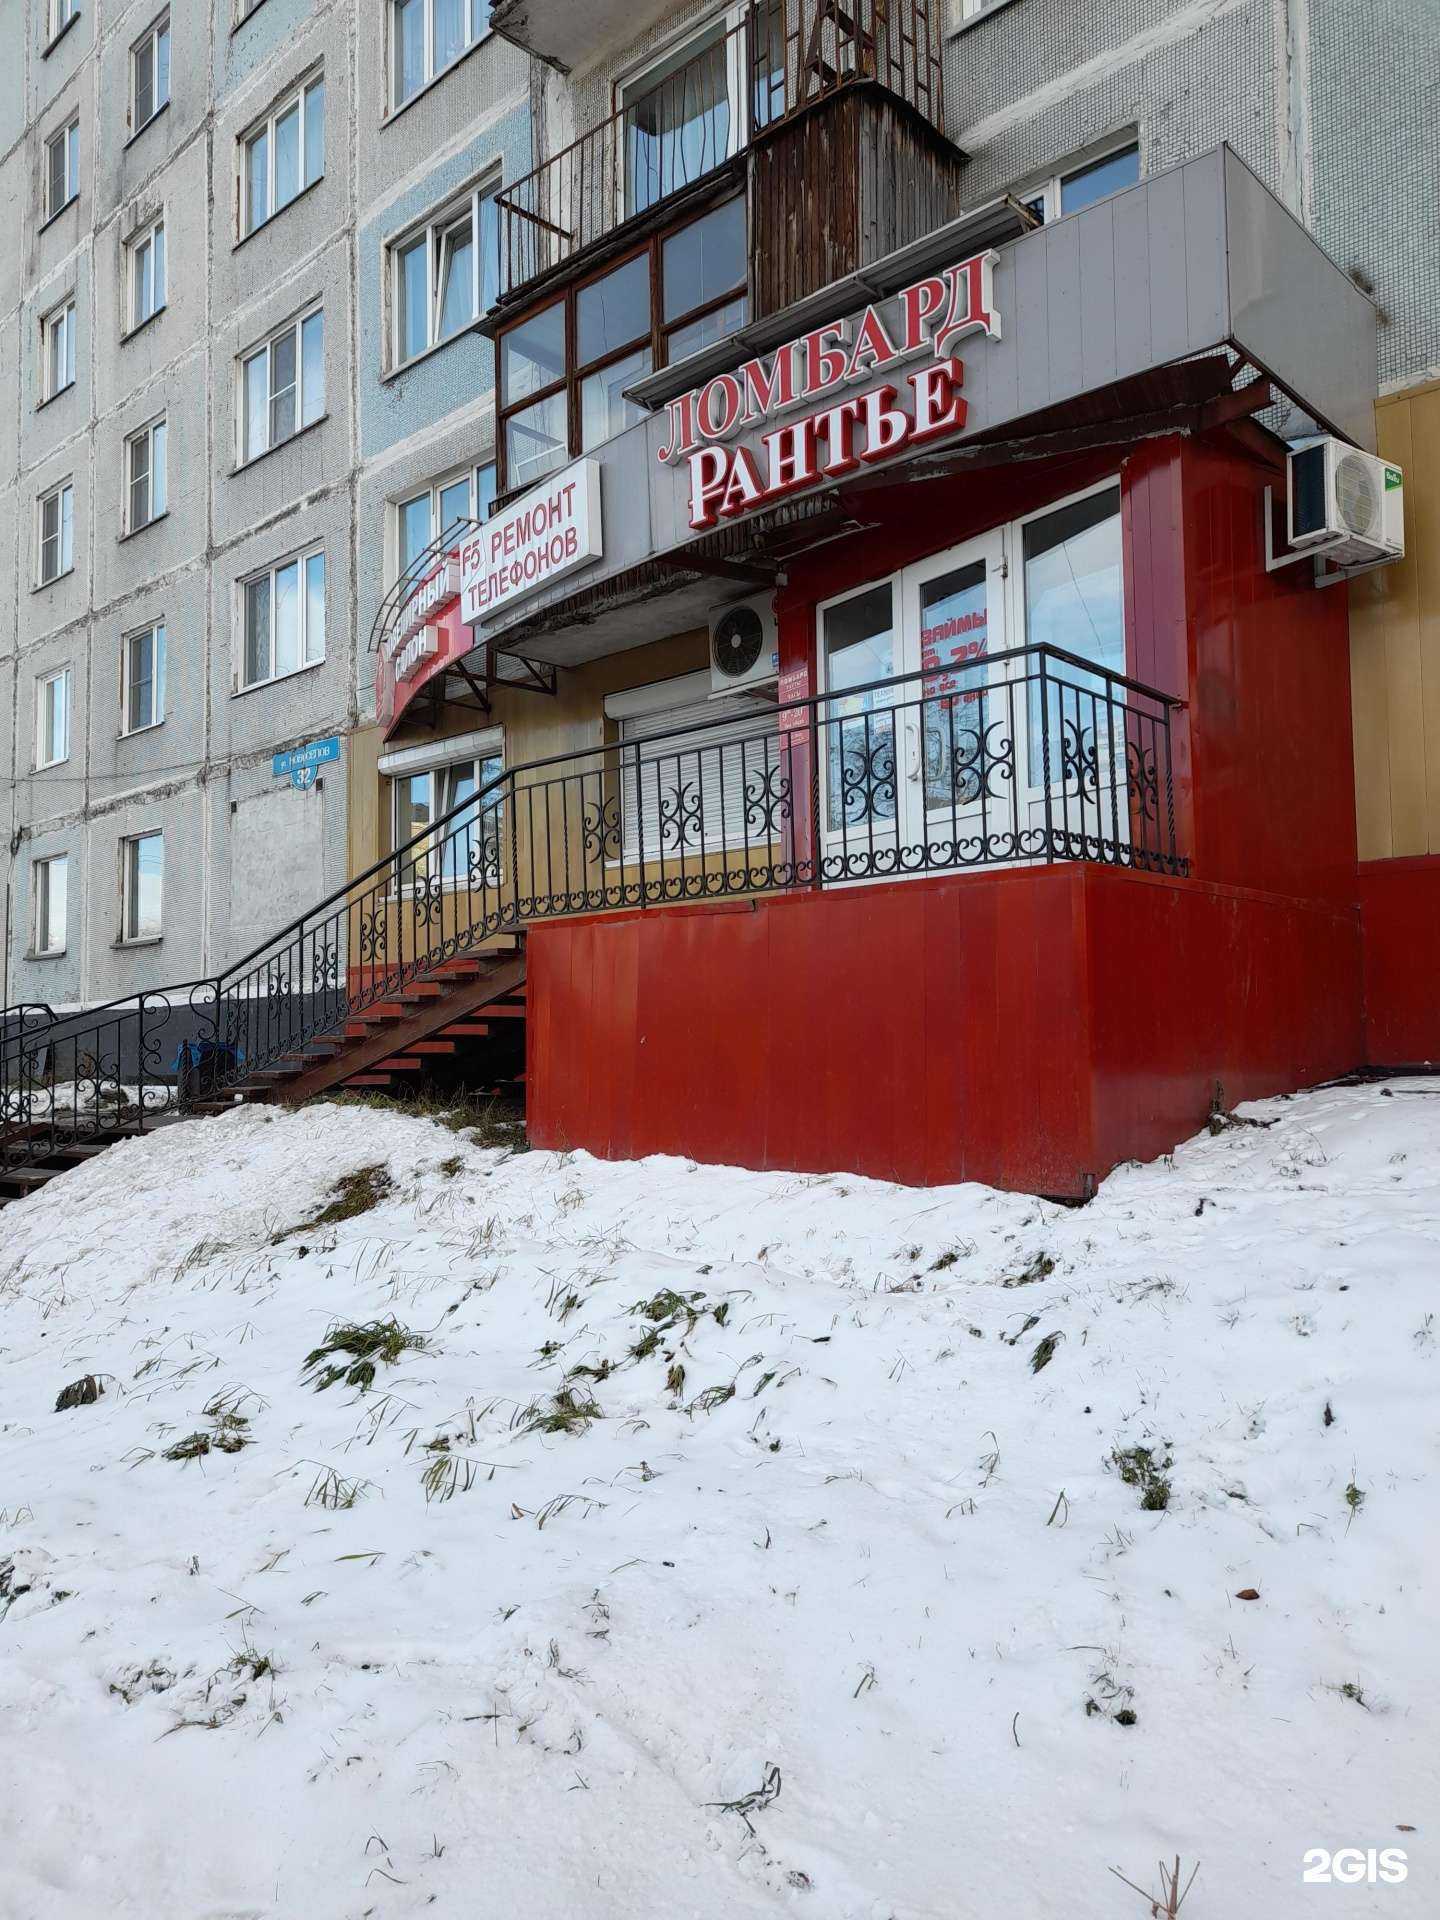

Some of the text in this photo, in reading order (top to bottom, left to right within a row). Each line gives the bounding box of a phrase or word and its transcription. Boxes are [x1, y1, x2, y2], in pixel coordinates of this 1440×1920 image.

[658, 249, 1001, 465] ЛОМБАРД
[688, 357, 967, 529] РАНТЬЕ
[463, 482, 576, 577] F5 РЕМОНТ
[468, 526, 578, 611] ТЕЛЕФОНОВ
[297, 767, 312, 784] 32
